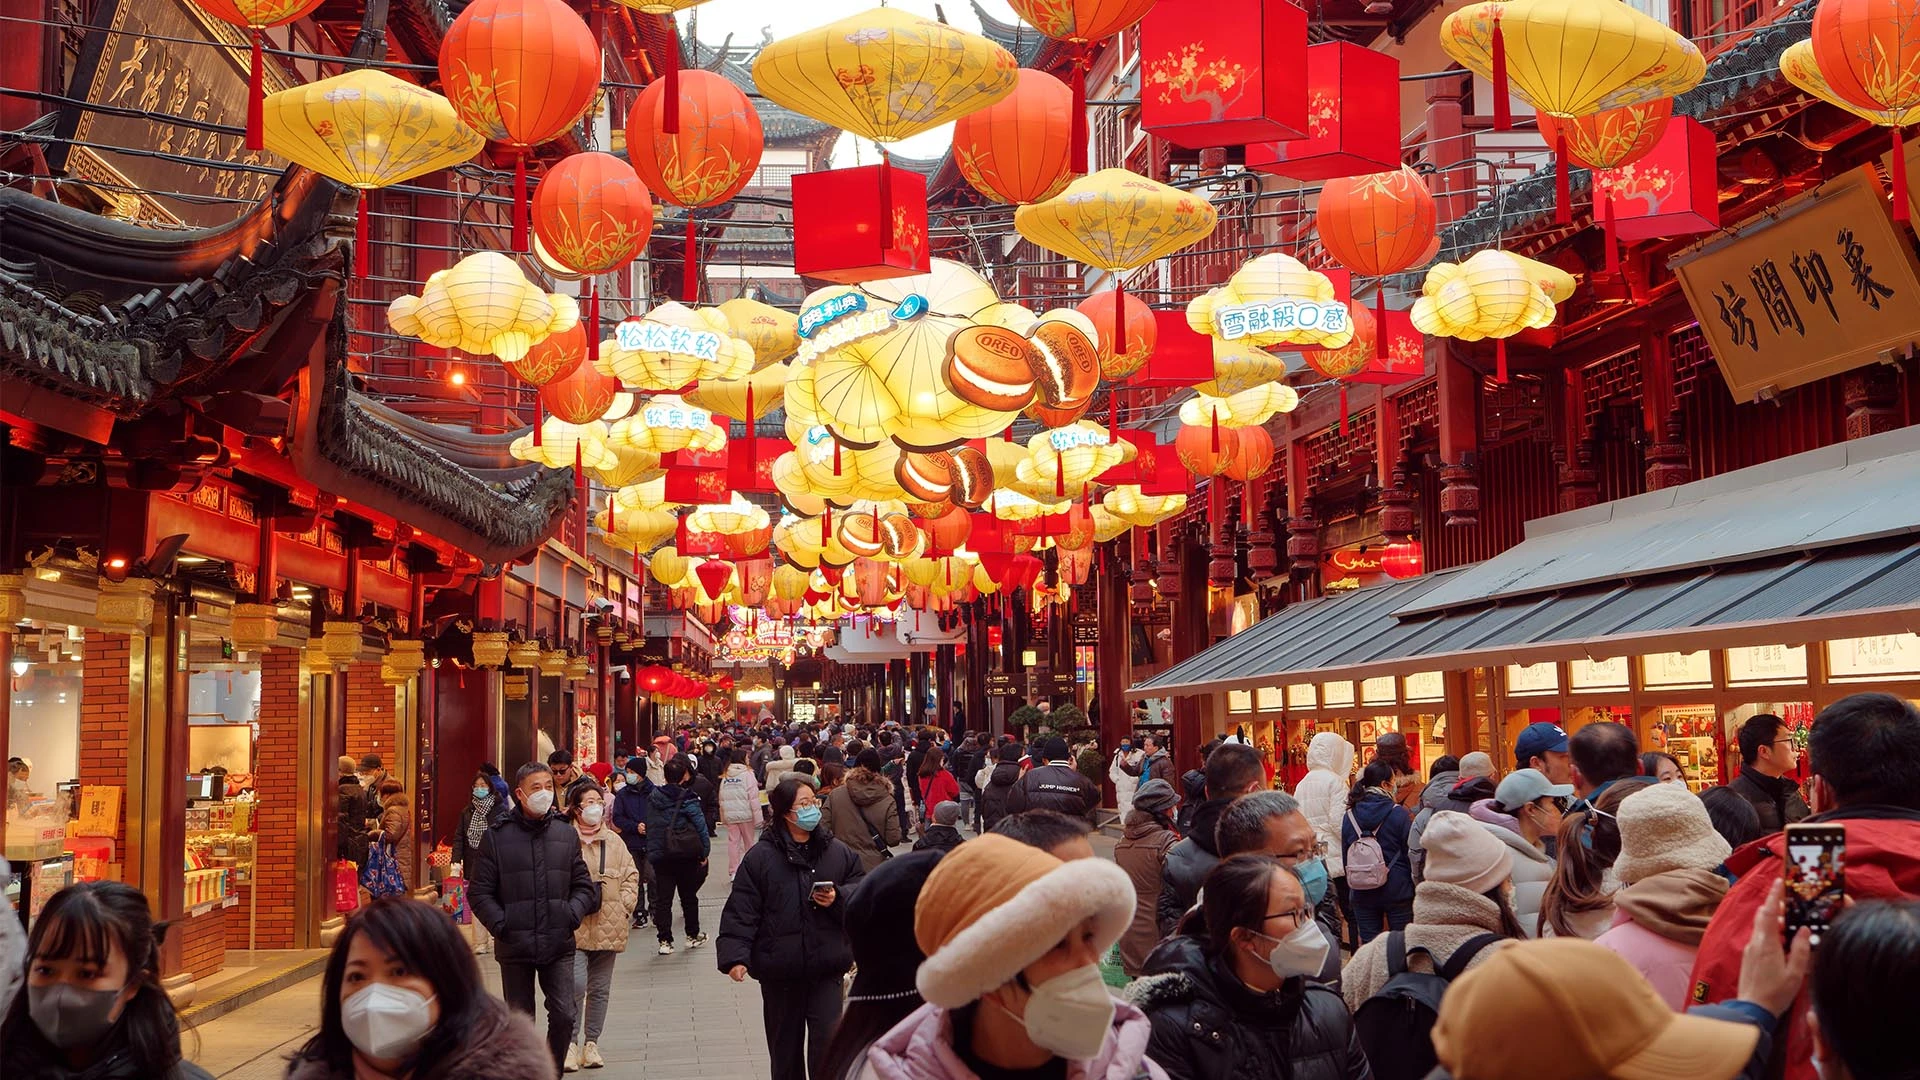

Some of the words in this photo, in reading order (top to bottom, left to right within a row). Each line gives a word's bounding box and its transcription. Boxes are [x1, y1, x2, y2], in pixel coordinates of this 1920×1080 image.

[801, 295, 858, 334] 奥利奥
[902, 302, 915, 315] 新
[1223, 305, 1345, 336] 雪融般口感
[619, 324, 718, 359] 松松软软
[981, 336, 1020, 358] OREO
[1069, 336, 1090, 369] OREO
[646, 409, 707, 428] 软奥奥
